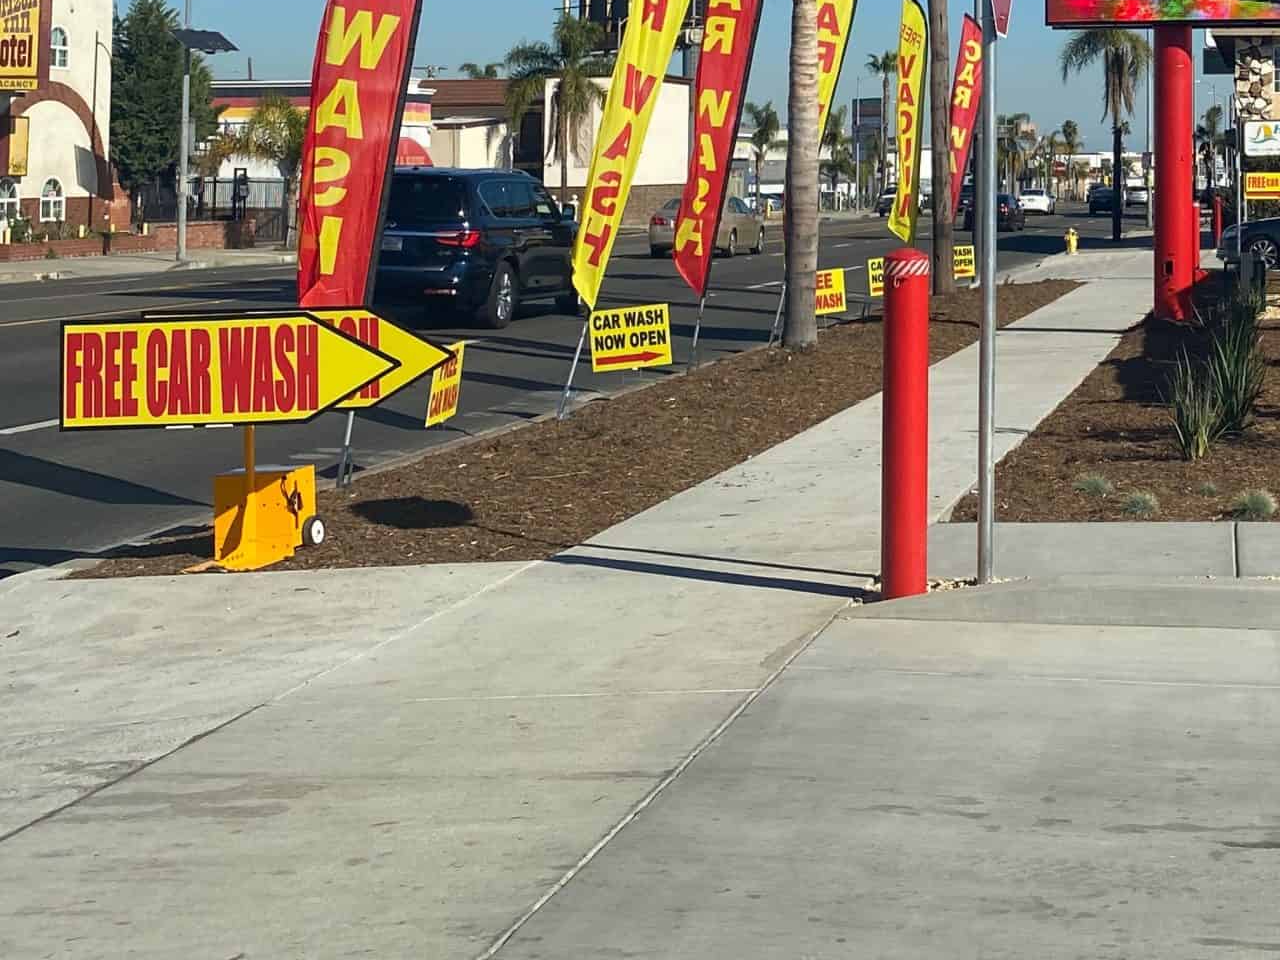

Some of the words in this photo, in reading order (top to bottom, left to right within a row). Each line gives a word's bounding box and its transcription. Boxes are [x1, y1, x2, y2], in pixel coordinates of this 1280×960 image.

[1248, 176, 1265, 188] FREE
[871, 261, 884, 271] CA
[954, 258, 973, 267] OPEN
[593, 314, 621, 331] CAR
[624, 309, 664, 328] WASH
[595, 333, 625, 351] NOW
[630, 329, 666, 347] OPEN
[66, 331, 138, 419] FREE
[146, 328, 211, 416] CAR
[218, 324, 318, 414] WASH
